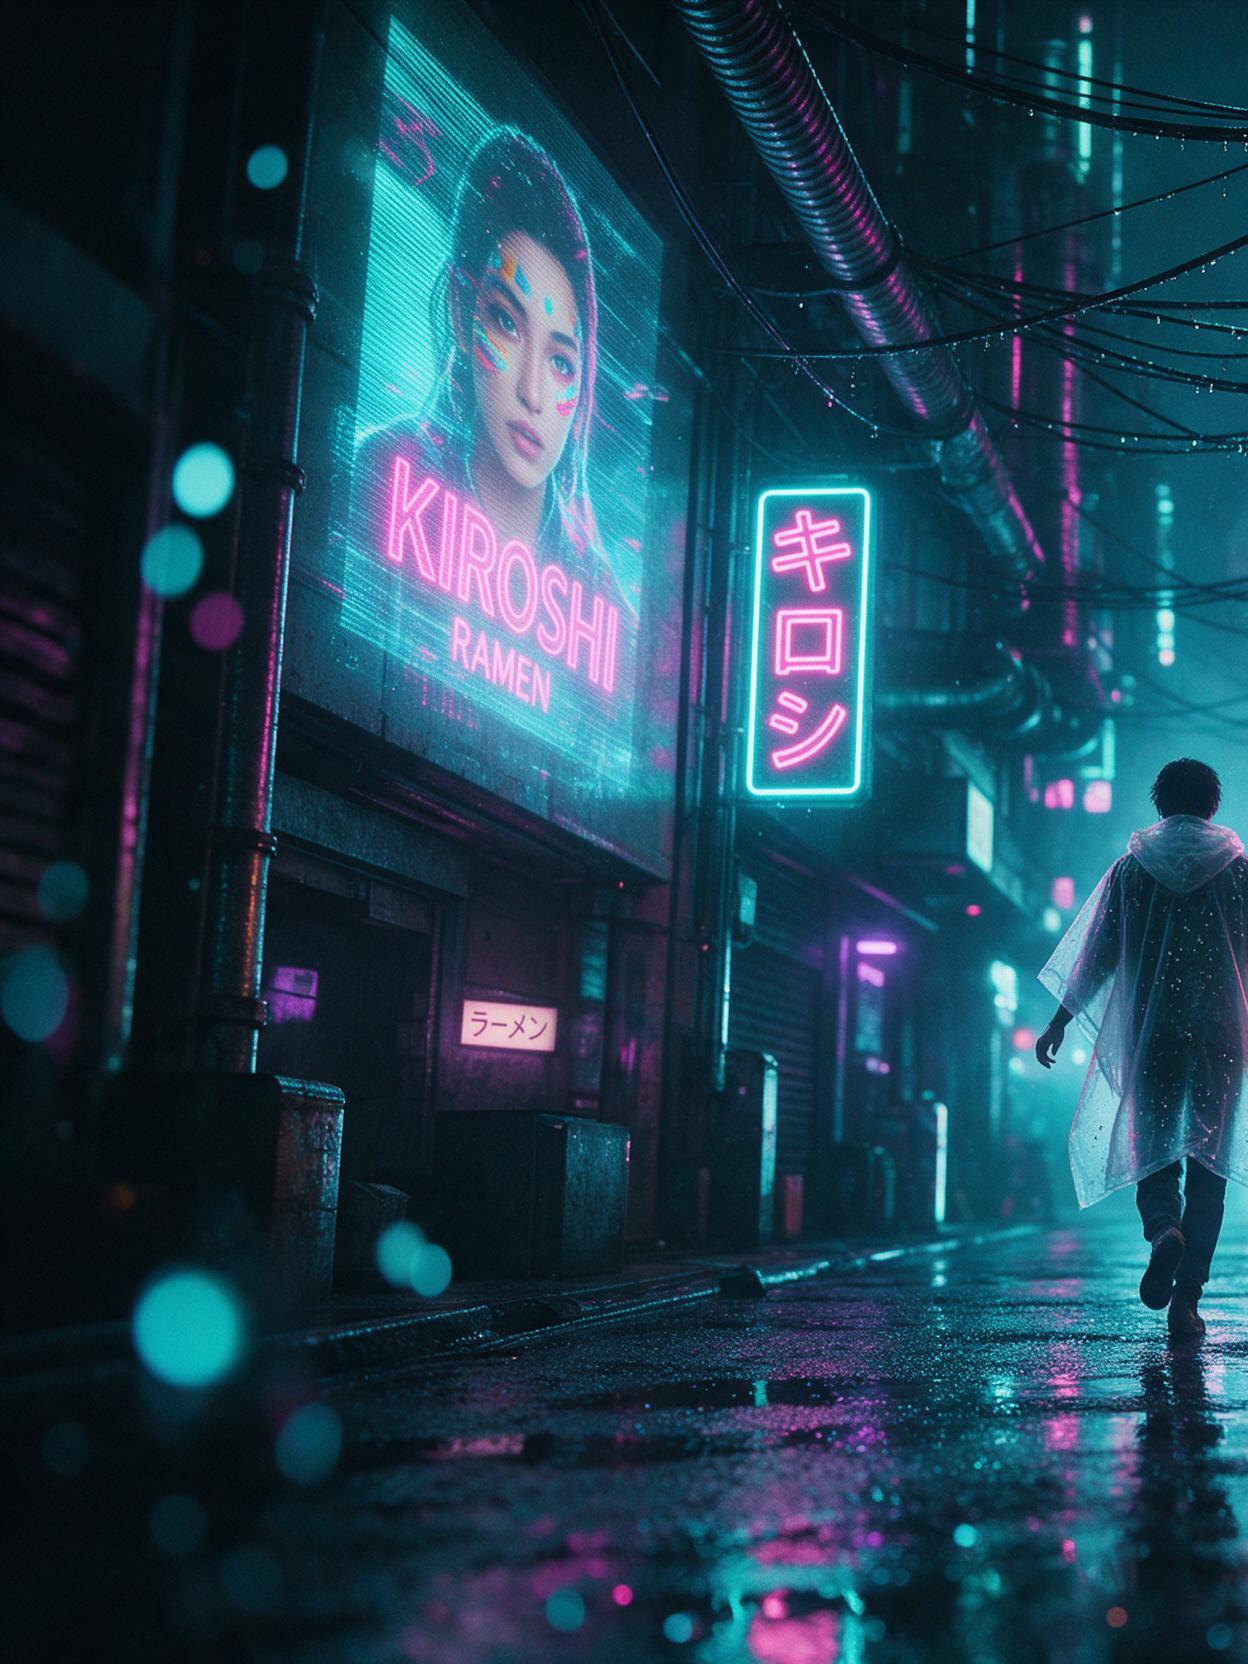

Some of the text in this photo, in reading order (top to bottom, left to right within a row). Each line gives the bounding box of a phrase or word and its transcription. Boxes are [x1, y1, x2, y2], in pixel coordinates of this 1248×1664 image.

[386, 454, 620, 696] KIROSHI
[769, 509, 852, 770] キロシ
[451, 616, 551, 714] RAMEN
[470, 1010, 548, 1041] ラーメン
